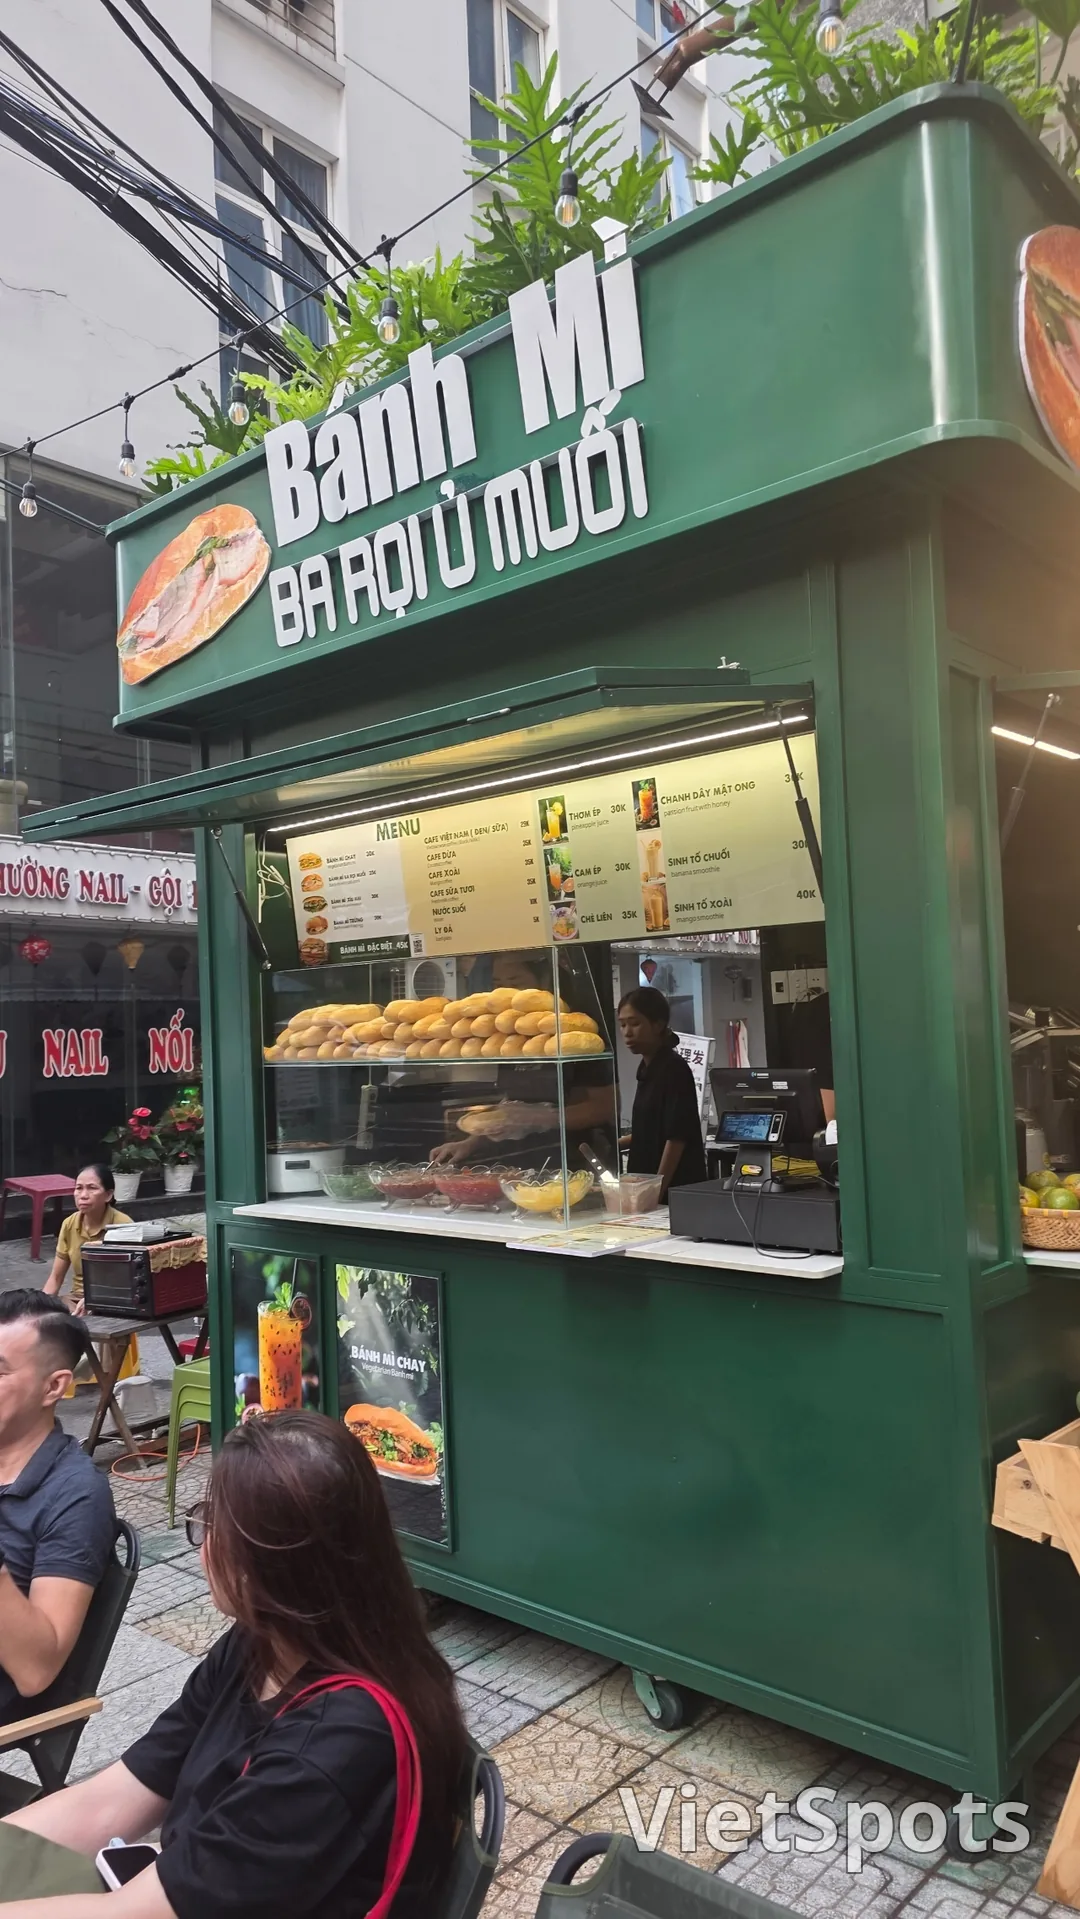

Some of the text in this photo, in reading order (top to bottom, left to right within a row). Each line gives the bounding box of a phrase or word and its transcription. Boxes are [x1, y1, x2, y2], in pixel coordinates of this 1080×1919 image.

[264, 215, 645, 547] Bánh Mì
[269, 554, 338, 648] BA
[339, 514, 428, 625] RỌI
[485, 388, 649, 572] MUỐI
[660, 771, 804, 804] CHANH DÂY MẬT ONG 3K
[568, 804, 627, 821] THƠM ÉP 30K
[663, 800, 731, 817] passion fruit with honey
[376, 818, 421, 841] MENU
[571, 819, 610, 831] pineapple juice
[423, 835, 439, 845] CAFE
[439, 832, 453, 842] VIỆT
[453, 830, 469, 840] NAM
[426, 852, 442, 862] CAFE
[668, 856, 689, 867] SINH
[689, 851, 702, 864] TỐ
[703, 846, 731, 862] CHUỐI
[428, 870, 443, 880] CAFE
[443, 867, 461, 878] XOÀI
[574, 862, 631, 877] CAM ÉP 30K
[671, 866, 721, 878] banana smoothie
[78, 868, 129, 905] NAIL
[148, 867, 183, 916] GỘI
[430, 888, 445, 898] CAFE
[451, 902, 467, 914] SUỐI
[674, 889, 816, 913] SINH TỐ XOÀI 40K
[580, 911, 638, 924] CHÈ LIÊN 35K
[676, 912, 725, 924] mango smoothie
[434, 926, 442, 935] LY
[340, 943, 357, 955] BÁNH
[366, 941, 380, 953] ĐẶC
[380, 940, 393, 952] BIỆT
[42, 1028, 109, 1078] NAIL
[148, 1008, 194, 1074] NỐI
[351, 1344, 427, 1373] BÁNH MÌ CHAY
[361, 1362, 391, 1376] Vegetarian
